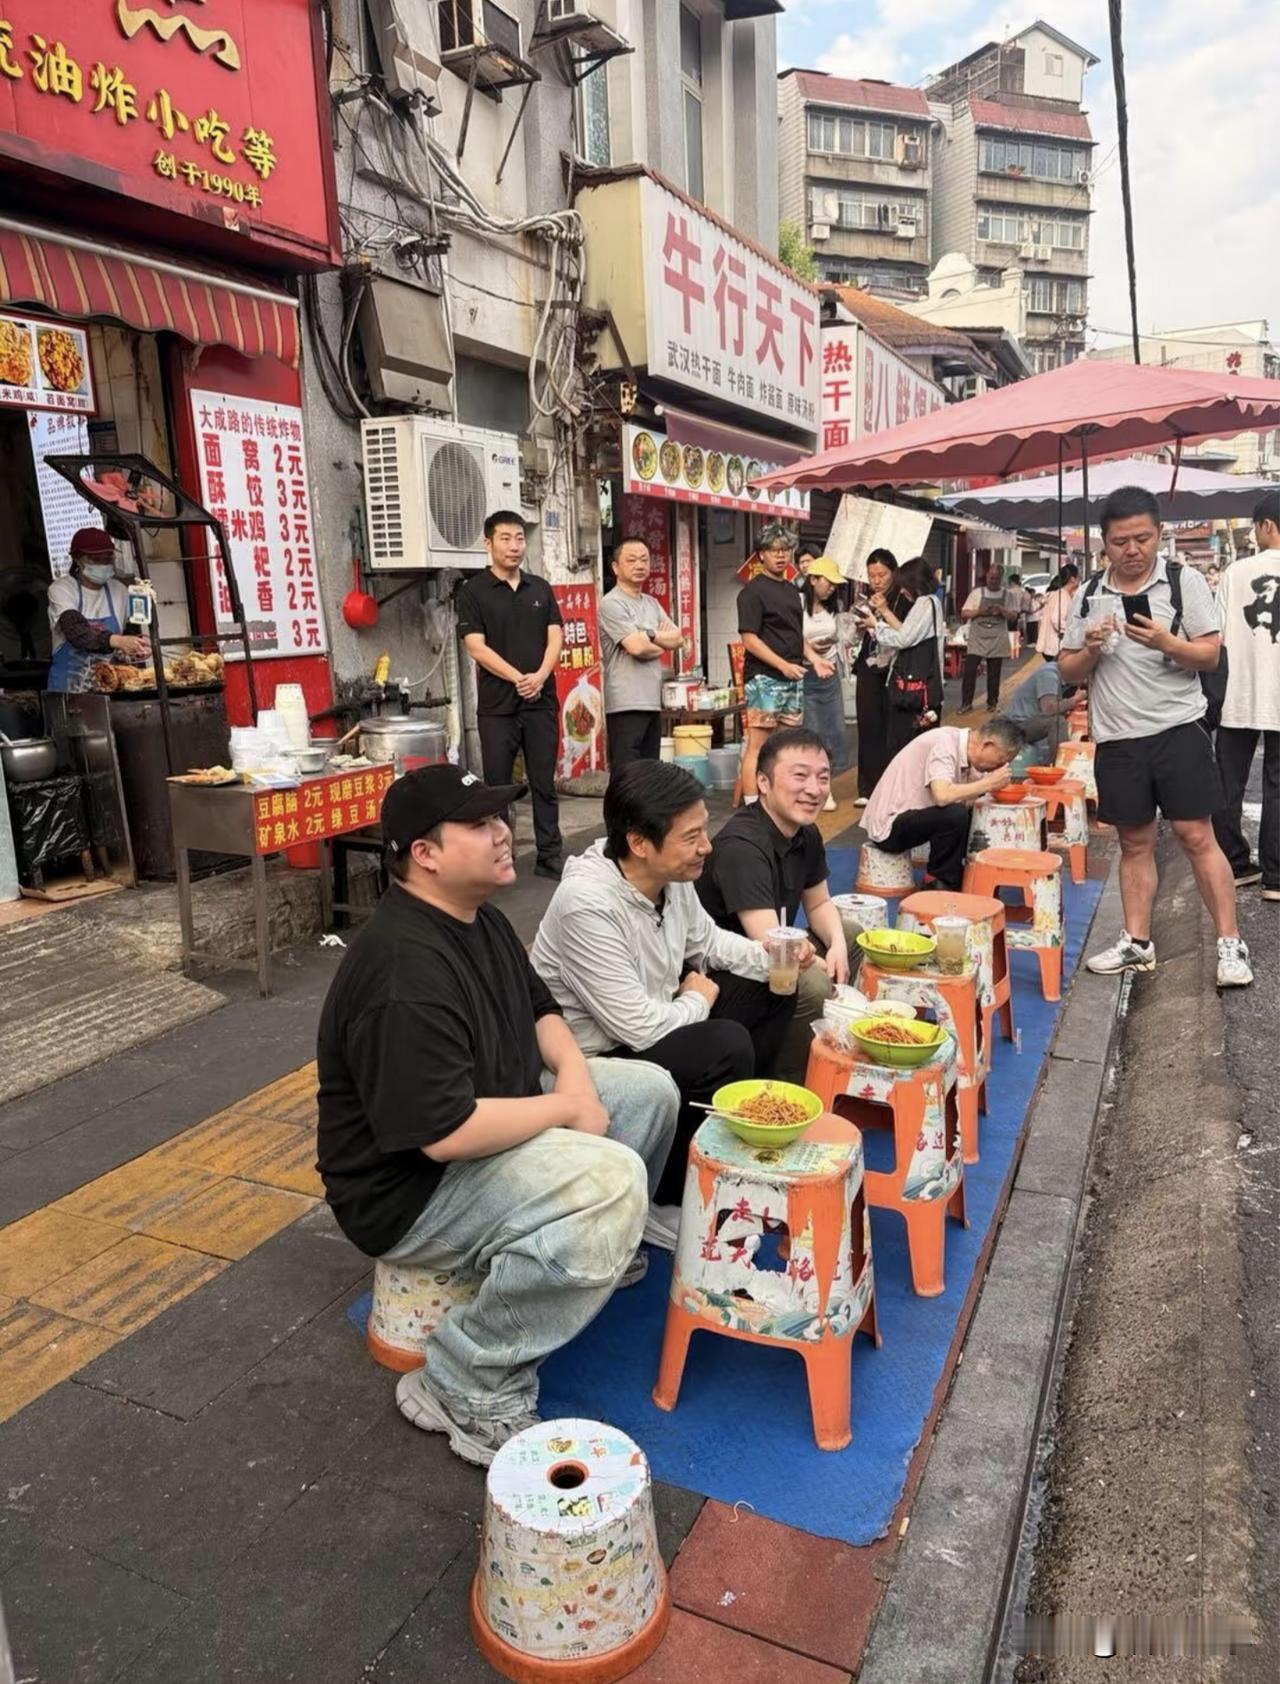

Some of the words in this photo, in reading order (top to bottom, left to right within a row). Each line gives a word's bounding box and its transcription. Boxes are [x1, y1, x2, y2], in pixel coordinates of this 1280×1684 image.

[662, 211, 815, 388] 牛行天下
[667, 340, 722, 387] 武汉热干面
[727, 367, 754, 400] 牛肉面
[822, 340, 853, 450] 热干面
[199, 404, 301, 442] 大成路的传统炸物
[273, 443, 303, 476] 2元
[277, 478, 307, 510] 3元
[280, 513, 309, 544] 3元
[284, 548, 313, 577] 2元
[287, 582, 316, 611] 2元
[292, 618, 321, 648] 3元
[258, 791, 298, 819] 豆腐脑
[304, 786, 324, 808] 2元
[258, 817, 299, 848] 矿泉水
[306, 813, 326, 835] 2元
